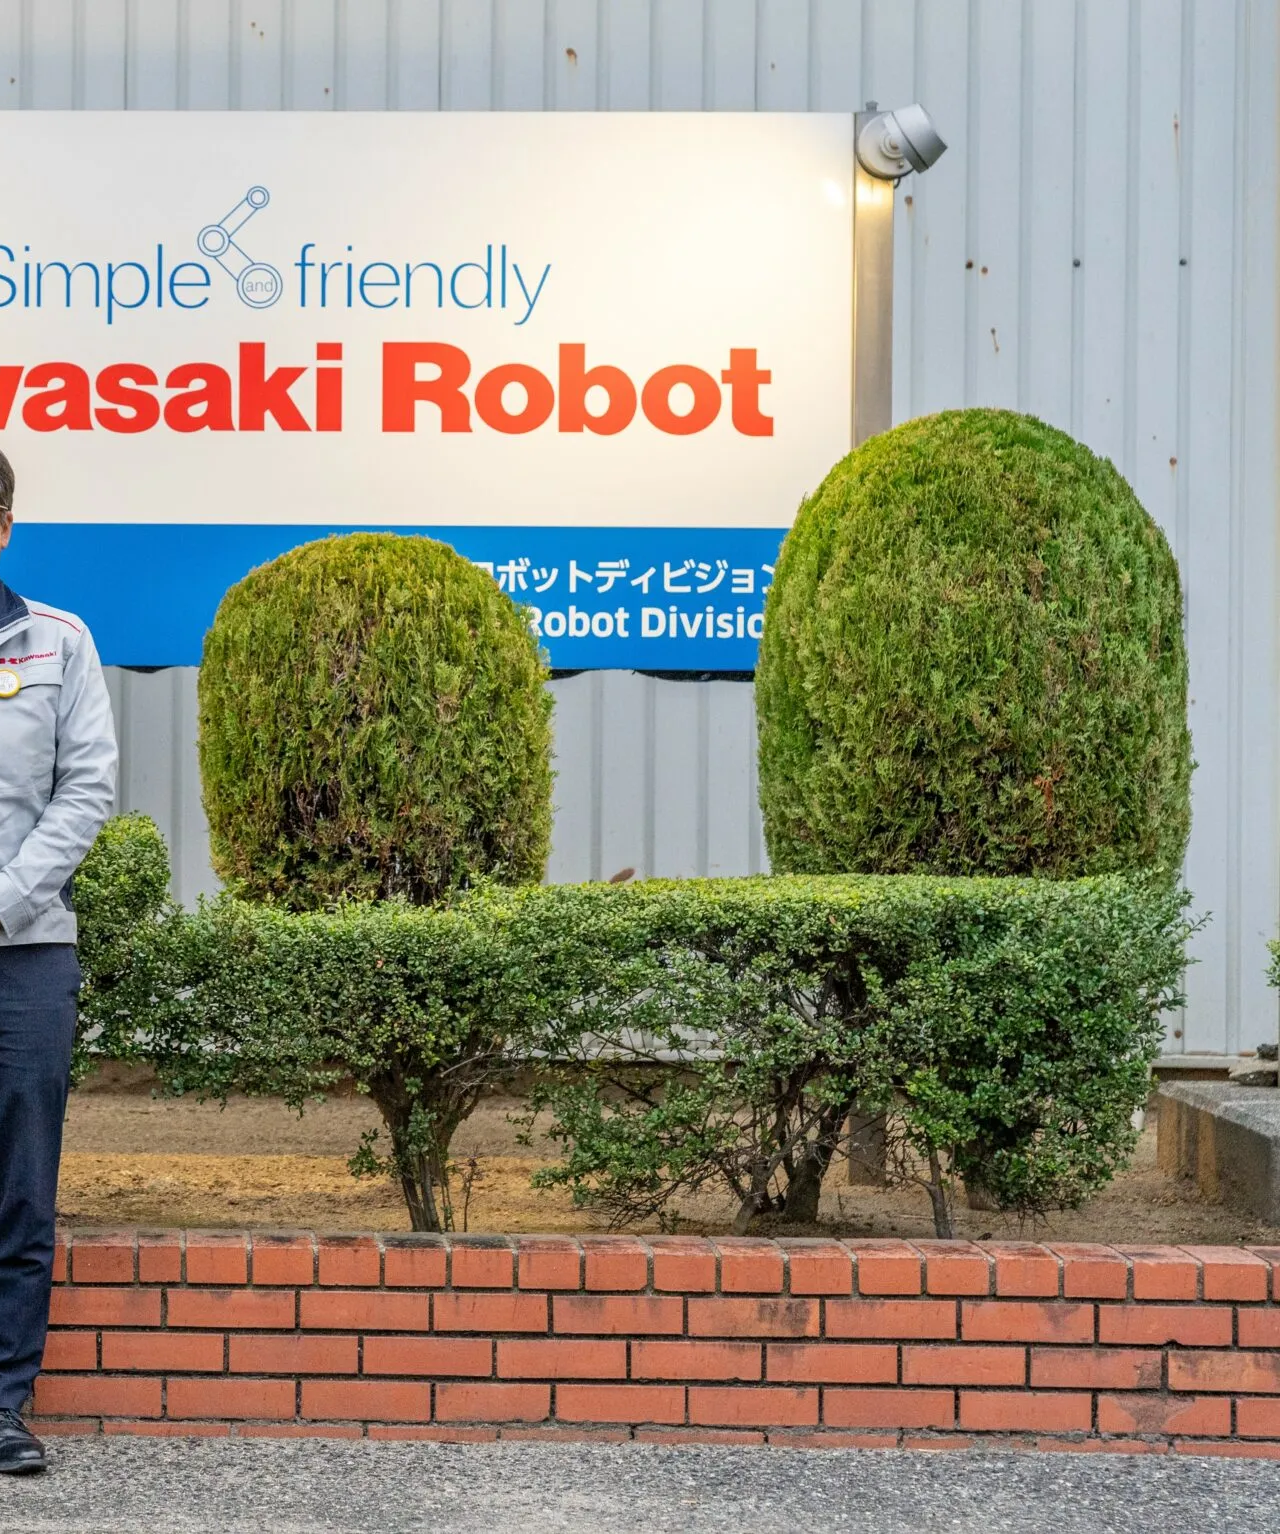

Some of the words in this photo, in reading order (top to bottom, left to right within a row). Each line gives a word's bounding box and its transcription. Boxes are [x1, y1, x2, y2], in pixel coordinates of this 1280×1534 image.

[245, 279, 274, 292] and
[294, 243, 552, 326] friendly
[381, 341, 774, 438] Robot
